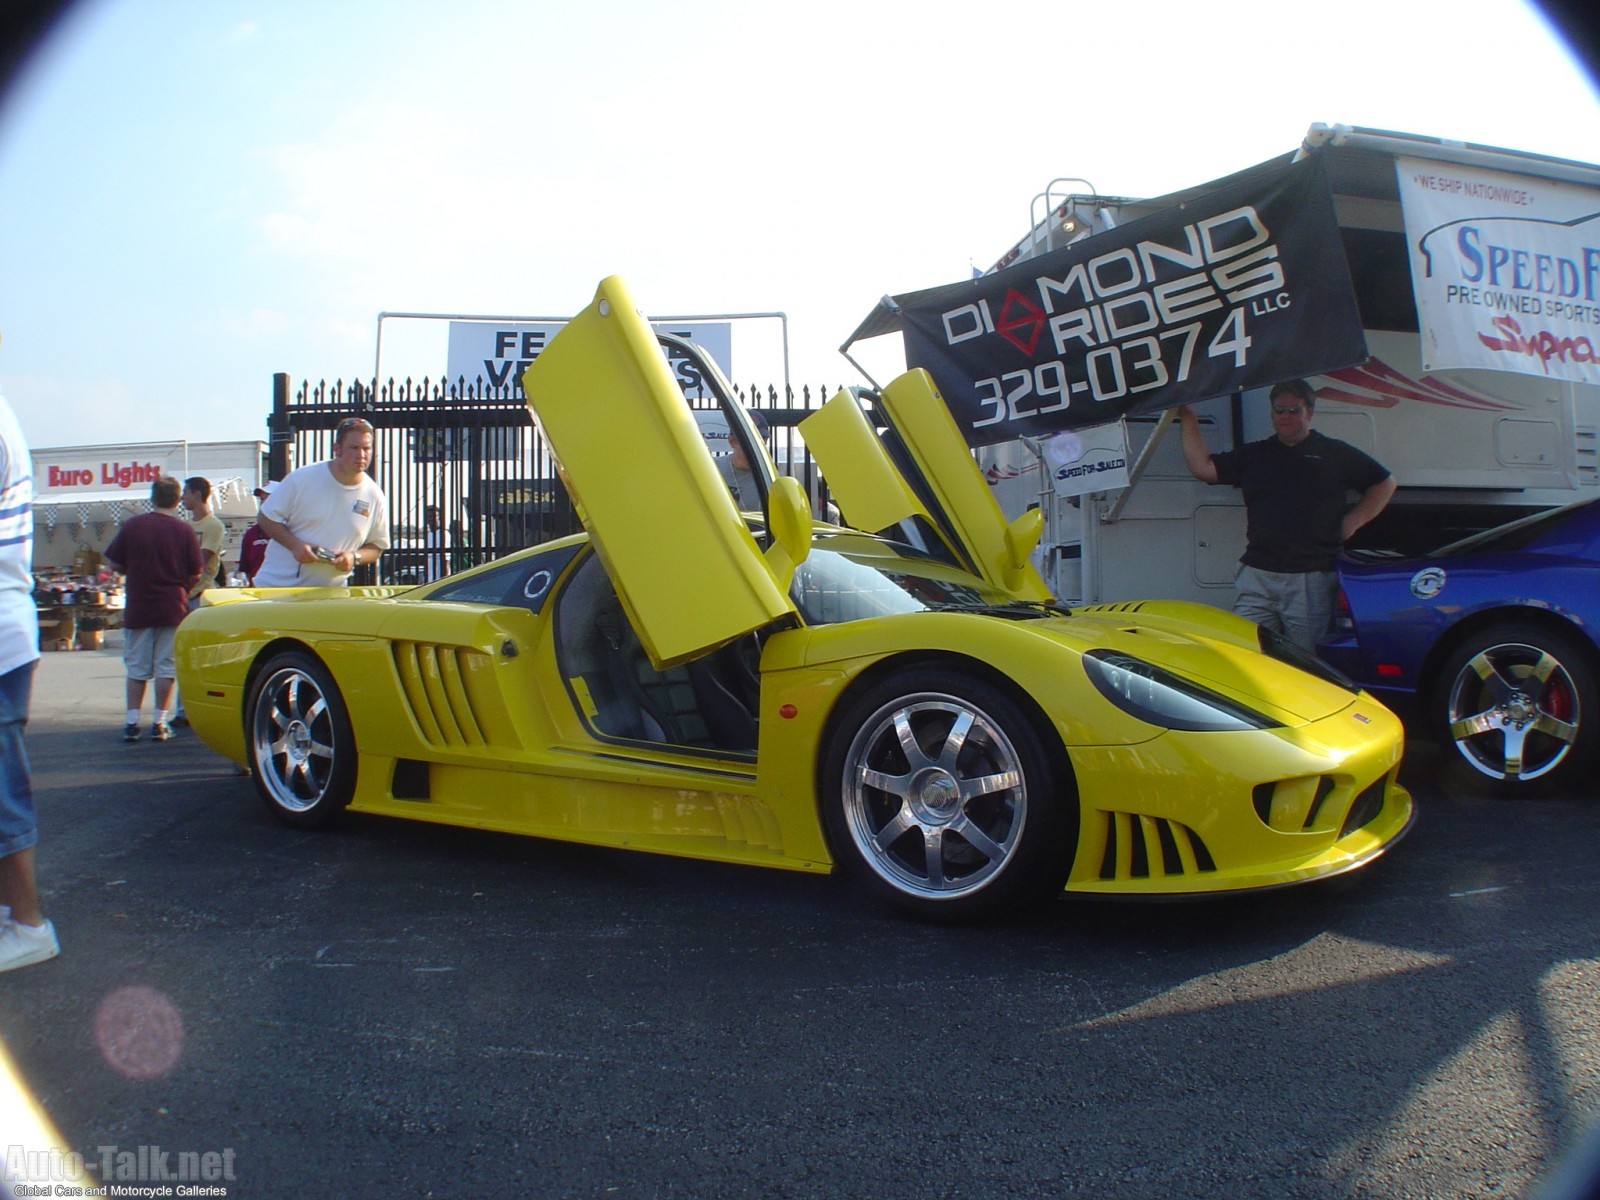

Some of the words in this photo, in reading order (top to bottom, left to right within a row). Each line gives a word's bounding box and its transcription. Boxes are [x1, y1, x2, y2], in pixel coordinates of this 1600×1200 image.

[1418, 174, 1437, 190] WE
[1438, 178, 1462, 194] SHIP
[1464, 182, 1528, 205] NATIONWIDE
[1049, 245, 1285, 354] RIDES
[1253, 292, 1291, 317] LLC
[1447, 285, 1481, 305] PRE
[1484, 291, 1541, 315] OWNED
[1545, 300, 1600, 325] SPORTS
[1477, 314, 1600, 375] Supra
[972, 307, 1251, 428] 329-0374
[48, 465, 93, 487] Euro
[101, 461, 161, 488] Lights
